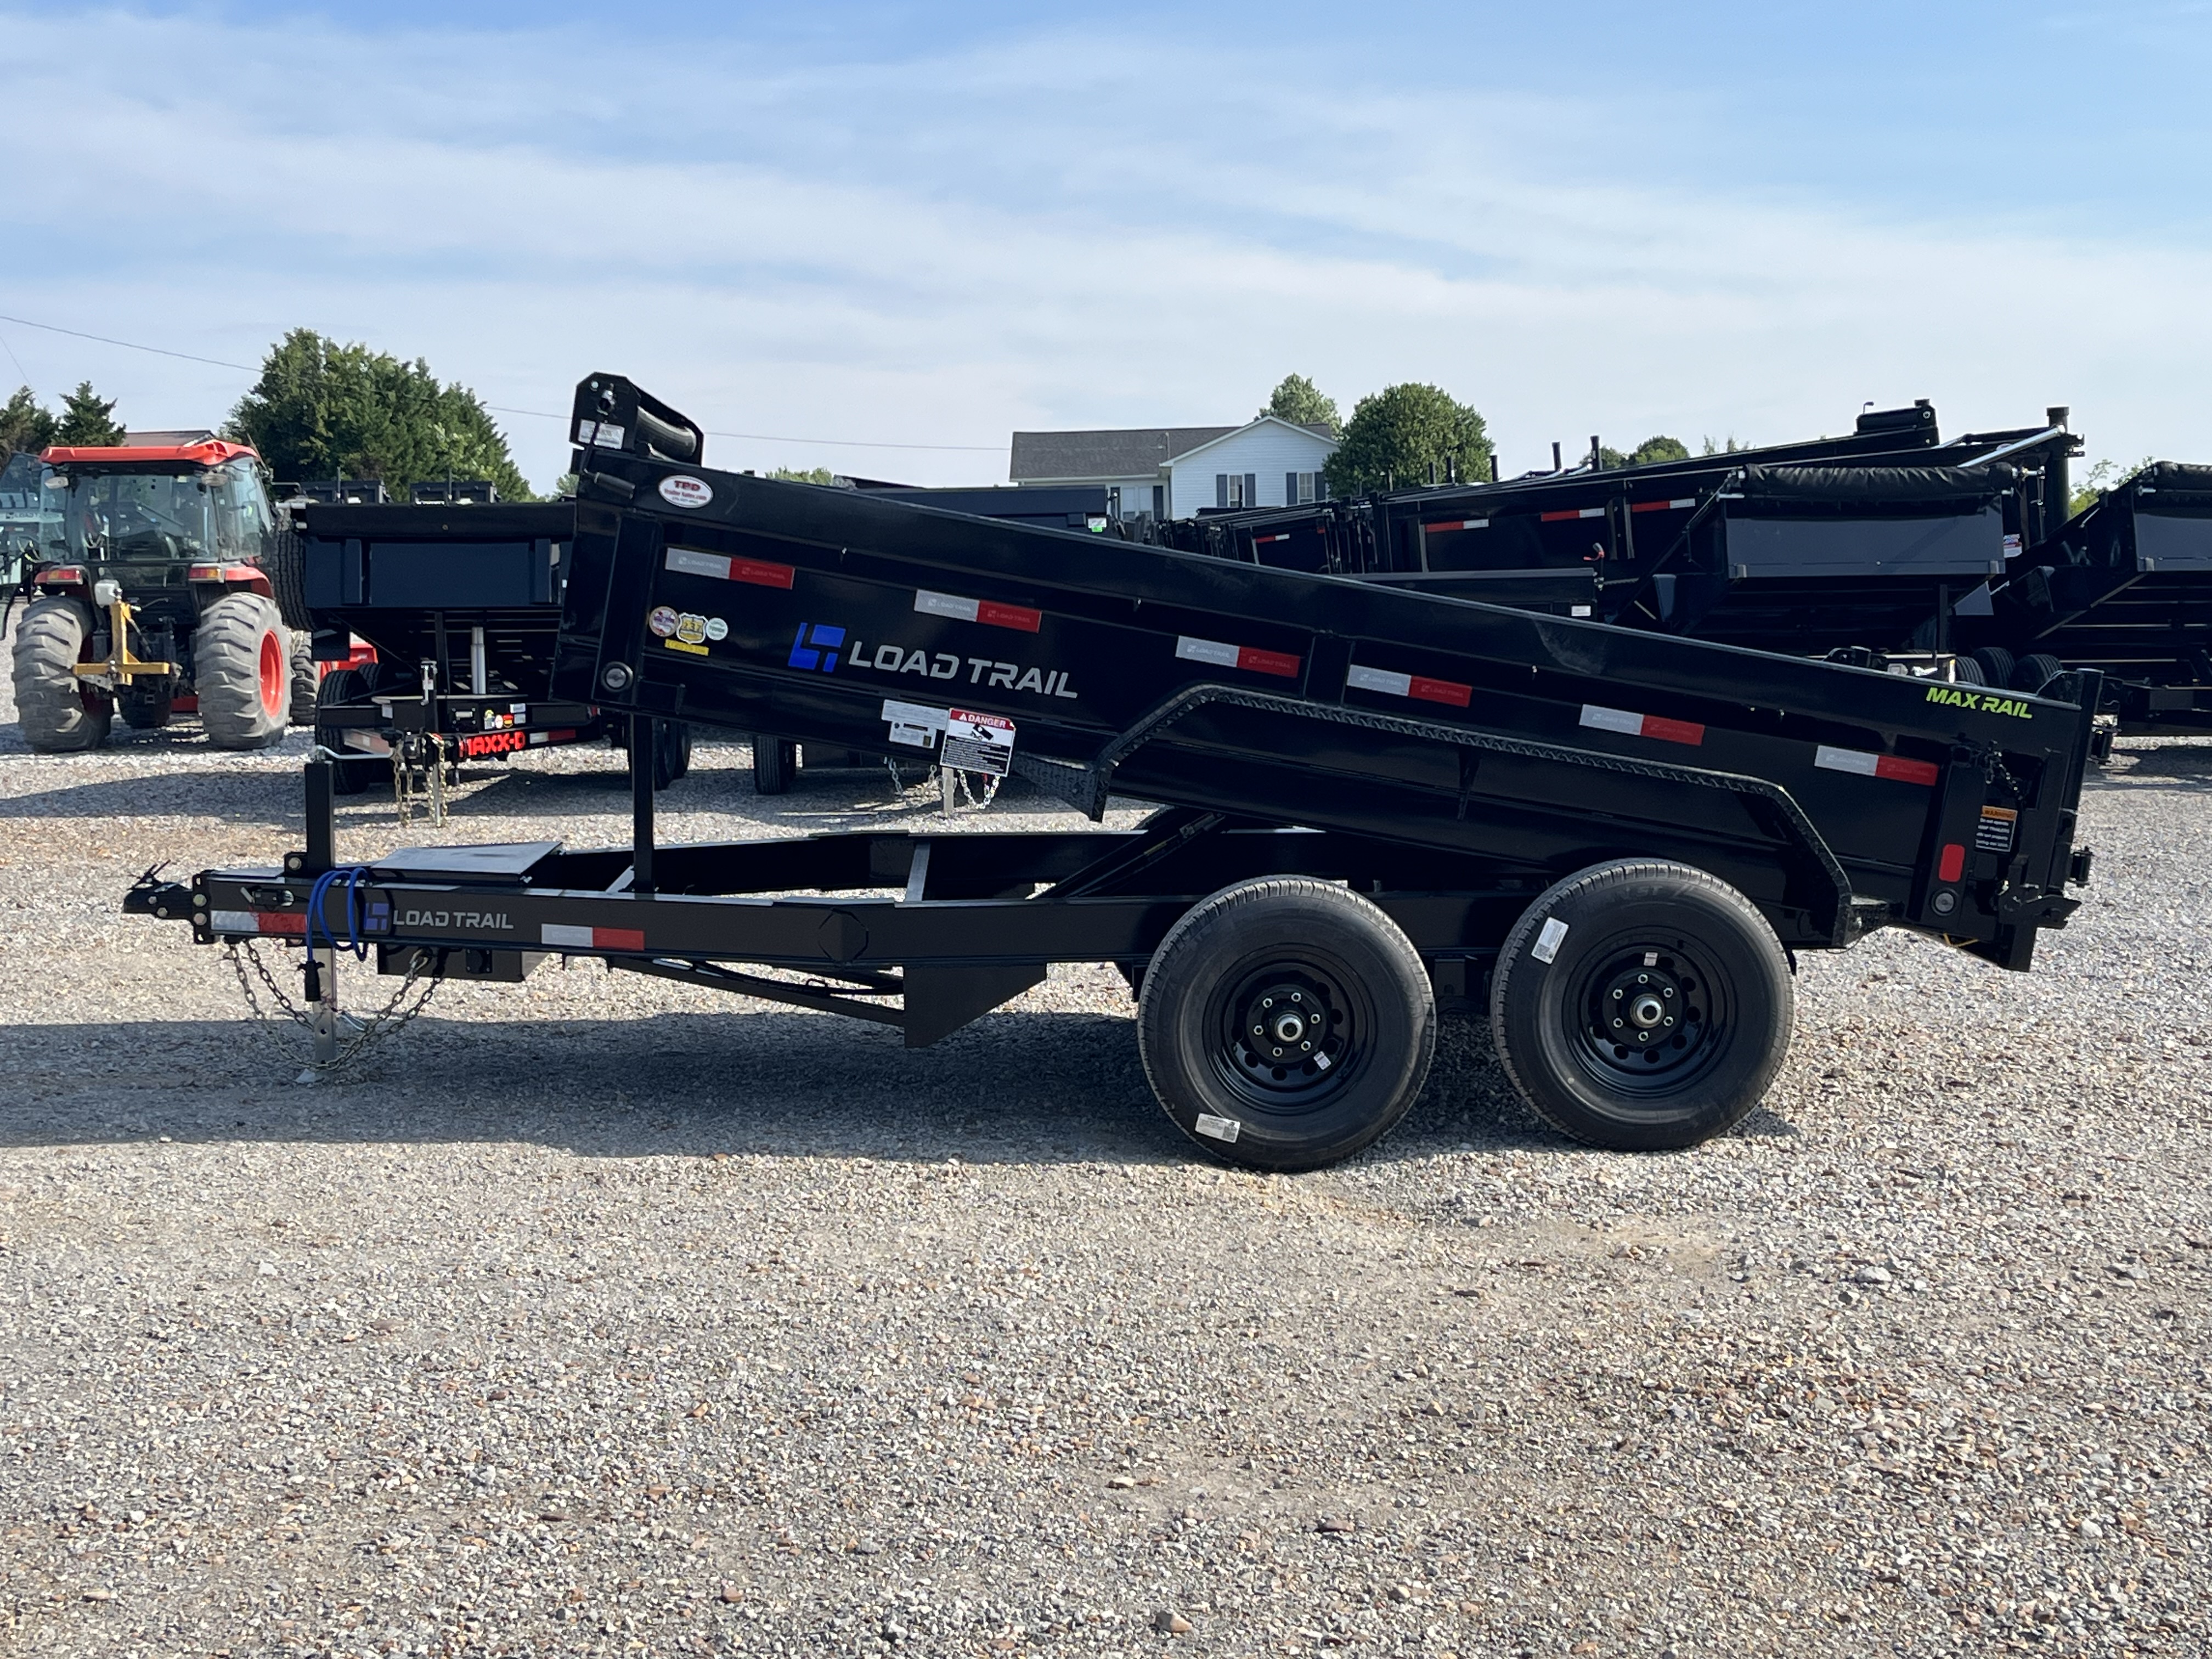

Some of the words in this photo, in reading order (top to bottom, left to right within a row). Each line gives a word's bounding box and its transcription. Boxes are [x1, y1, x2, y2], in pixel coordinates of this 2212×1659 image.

[849, 641, 960, 680] LOAD
[967, 657, 1079, 698] TRAIL
[1926, 687, 1980, 709] MAX
[1981, 697, 2033, 719] RAIL
[968, 714, 1006, 729] DANGER
[393, 910, 449, 927] LOAD
[453, 912, 514, 929] TRAIL
